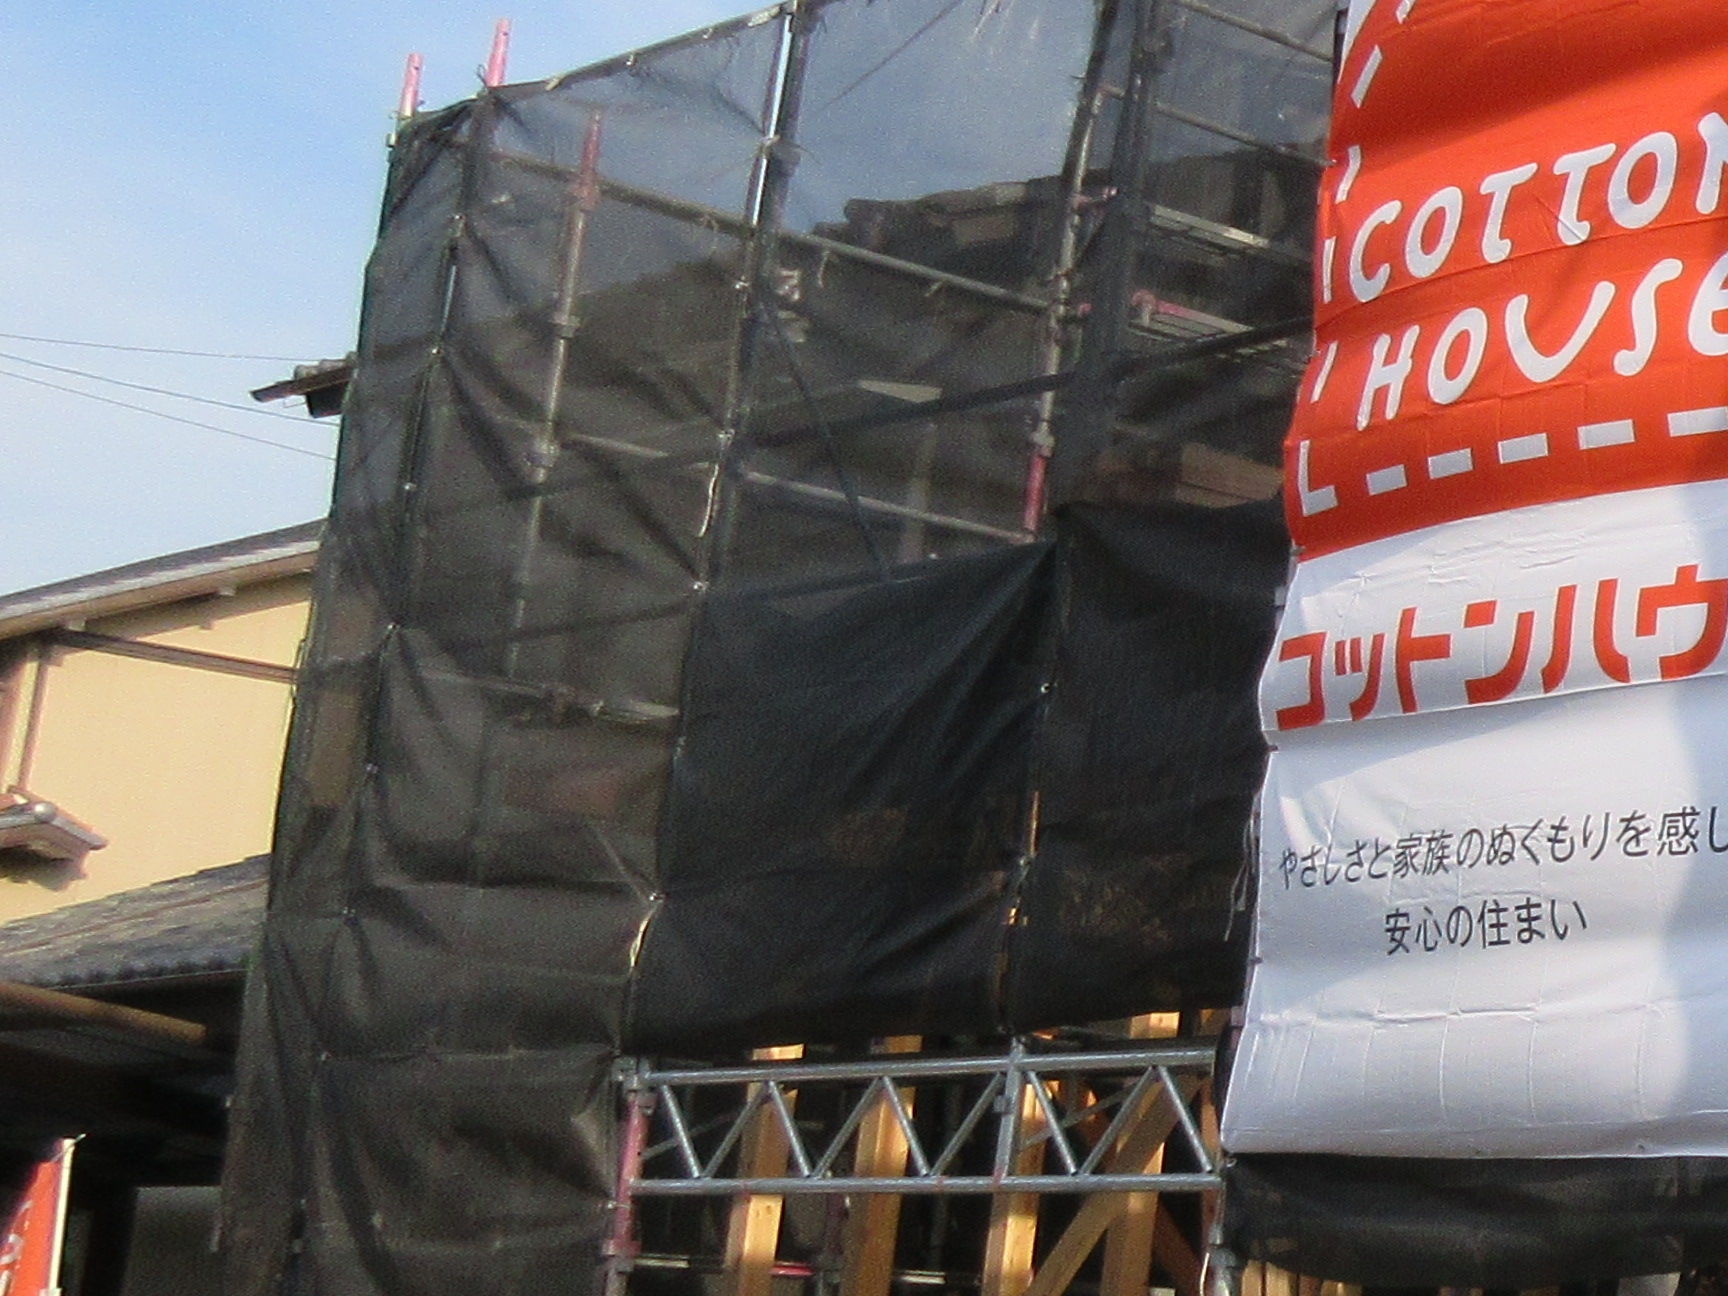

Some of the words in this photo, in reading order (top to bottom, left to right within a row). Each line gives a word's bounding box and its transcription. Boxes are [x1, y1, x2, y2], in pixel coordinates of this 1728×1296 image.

[1384, 897, 1588, 956] 安心の住まい
